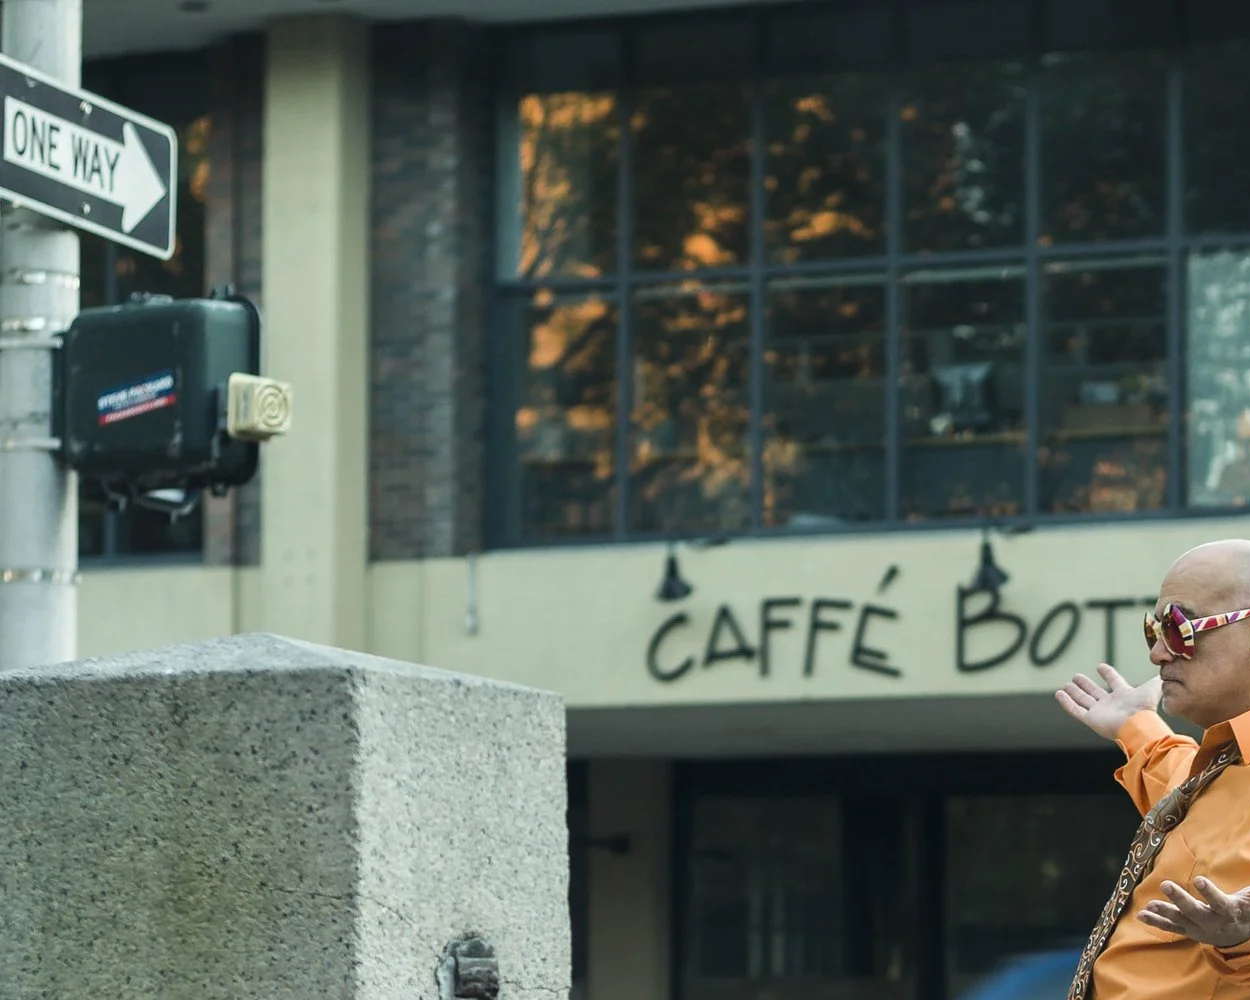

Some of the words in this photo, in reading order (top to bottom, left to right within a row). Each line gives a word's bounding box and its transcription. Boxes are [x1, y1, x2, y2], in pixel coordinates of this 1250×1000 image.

[13, 110, 60, 170] ONE
[71, 133, 120, 193] WAY
[647, 565, 903, 683] CAFFÉ
